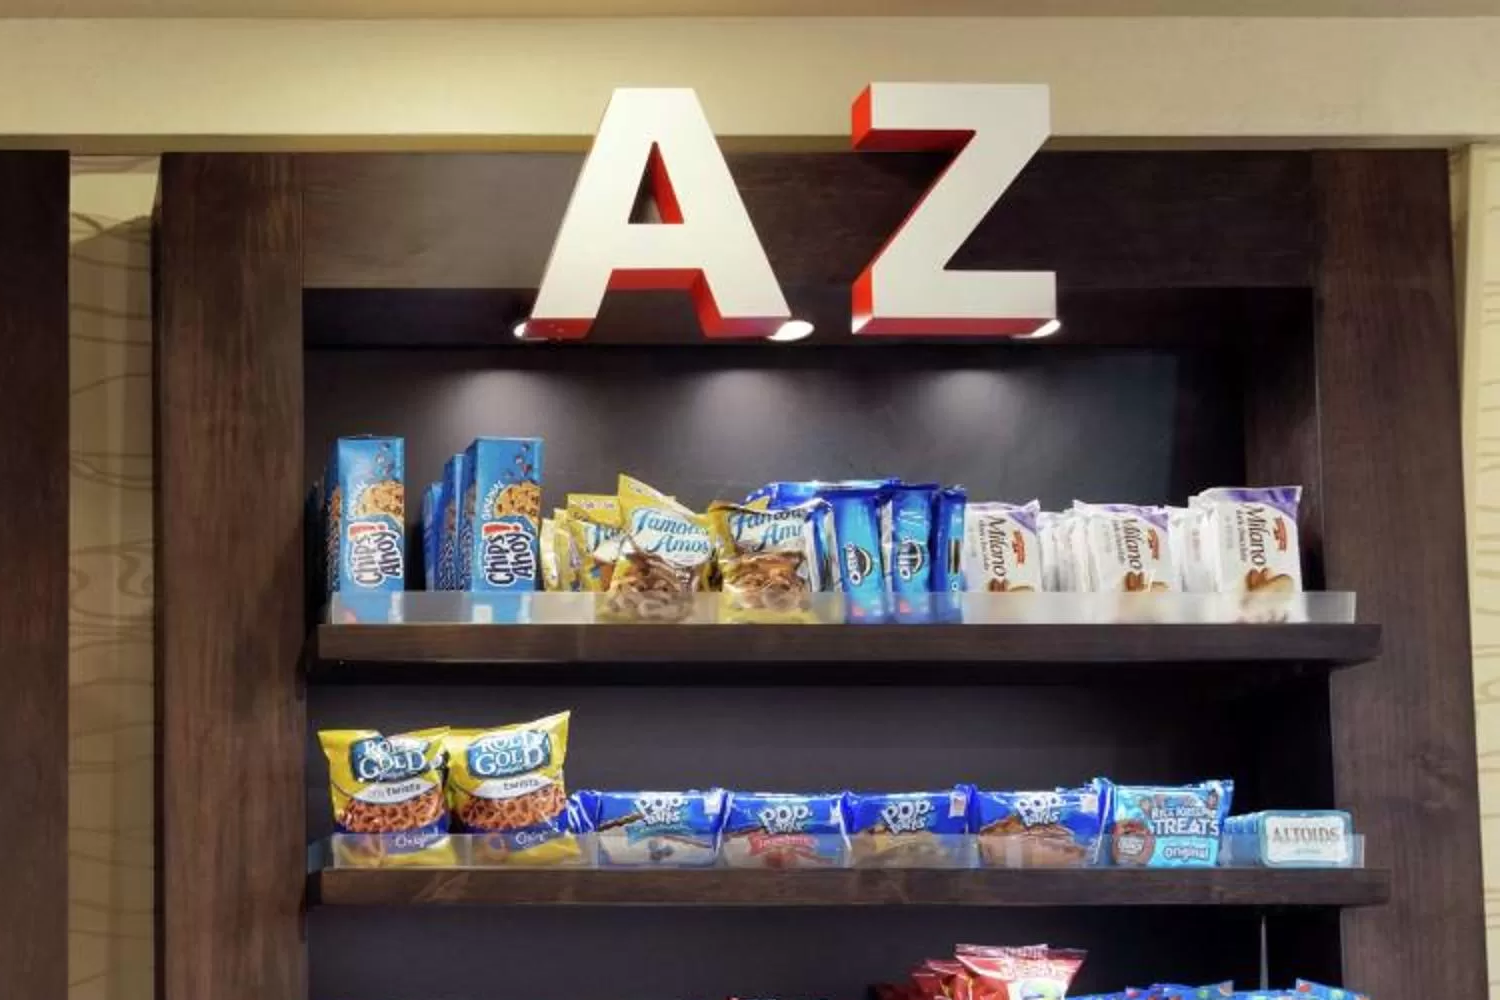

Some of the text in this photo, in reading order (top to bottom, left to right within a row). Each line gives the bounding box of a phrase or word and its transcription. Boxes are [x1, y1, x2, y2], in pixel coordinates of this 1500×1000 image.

[989, 516, 1007, 579] Milano
[1247, 506, 1268, 566] Milano
[359, 754, 428, 780] GOLD
[476, 748, 545, 776] GOLD
[1154, 818, 1220, 836] TREATS
